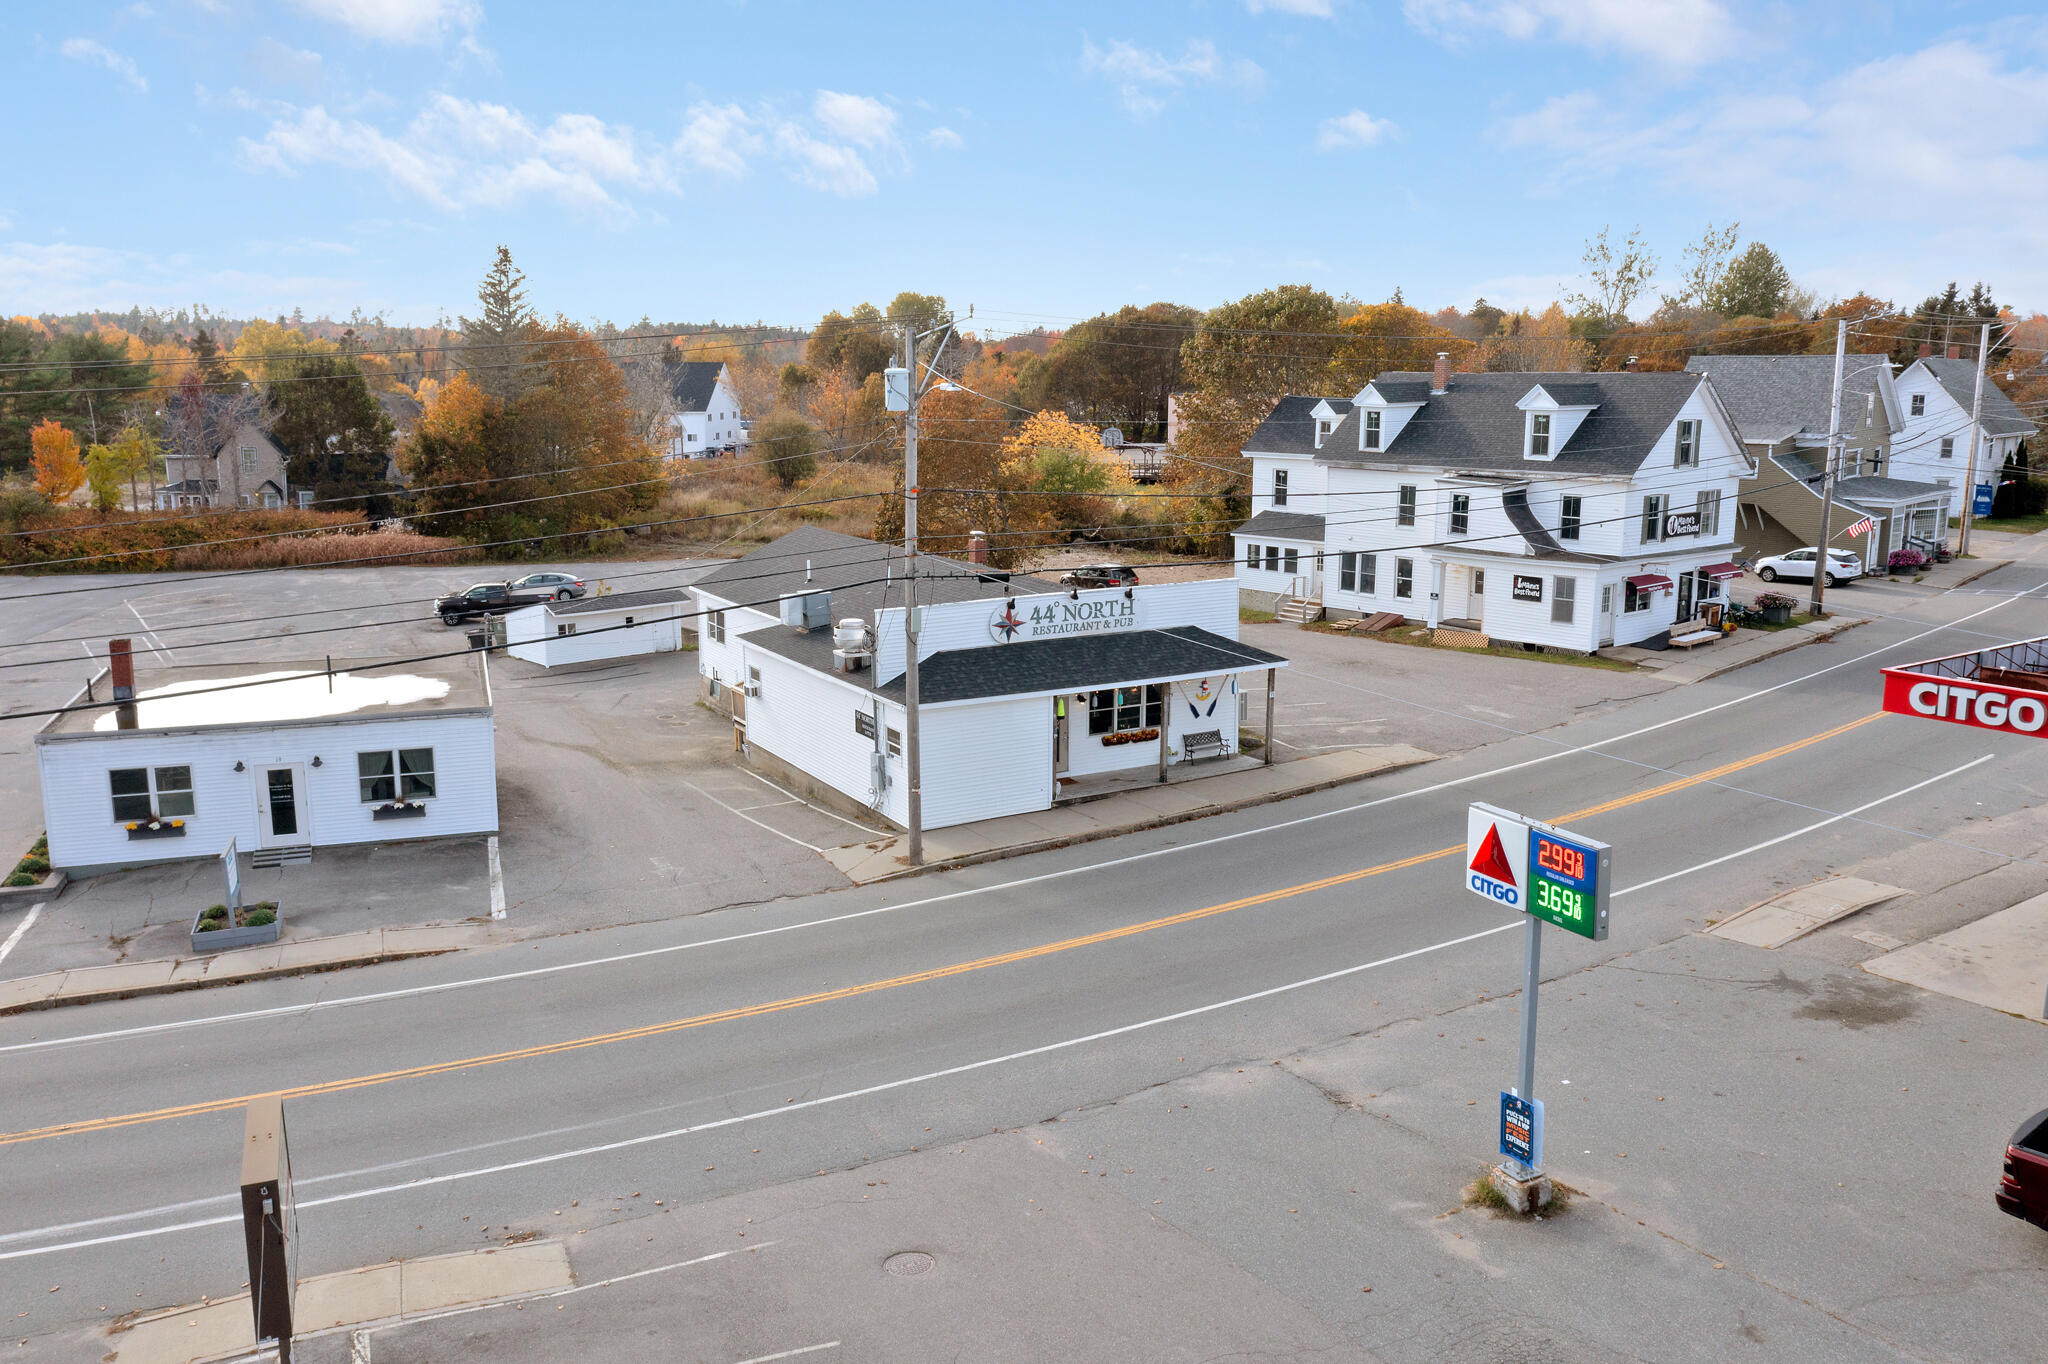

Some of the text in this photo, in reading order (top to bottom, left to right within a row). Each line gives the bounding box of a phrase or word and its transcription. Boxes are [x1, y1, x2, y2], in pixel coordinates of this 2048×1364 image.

[1062, 599, 1136, 622] NORTH
[1032, 618, 1134, 635] RESTAURANT & PUB
[1908, 682, 2046, 732] CITGO
[1538, 839, 1574, 876] 2.99
[1471, 874, 1518, 905] CITGO
[1537, 880, 1572, 917] 3.69
[1506, 1115, 1517, 1125] WIN
[1506, 1121, 1529, 1137] MUSIC
[1506, 1128, 1529, 1143] FEST
[1506, 1134, 1529, 1151] EXPERIENCE
